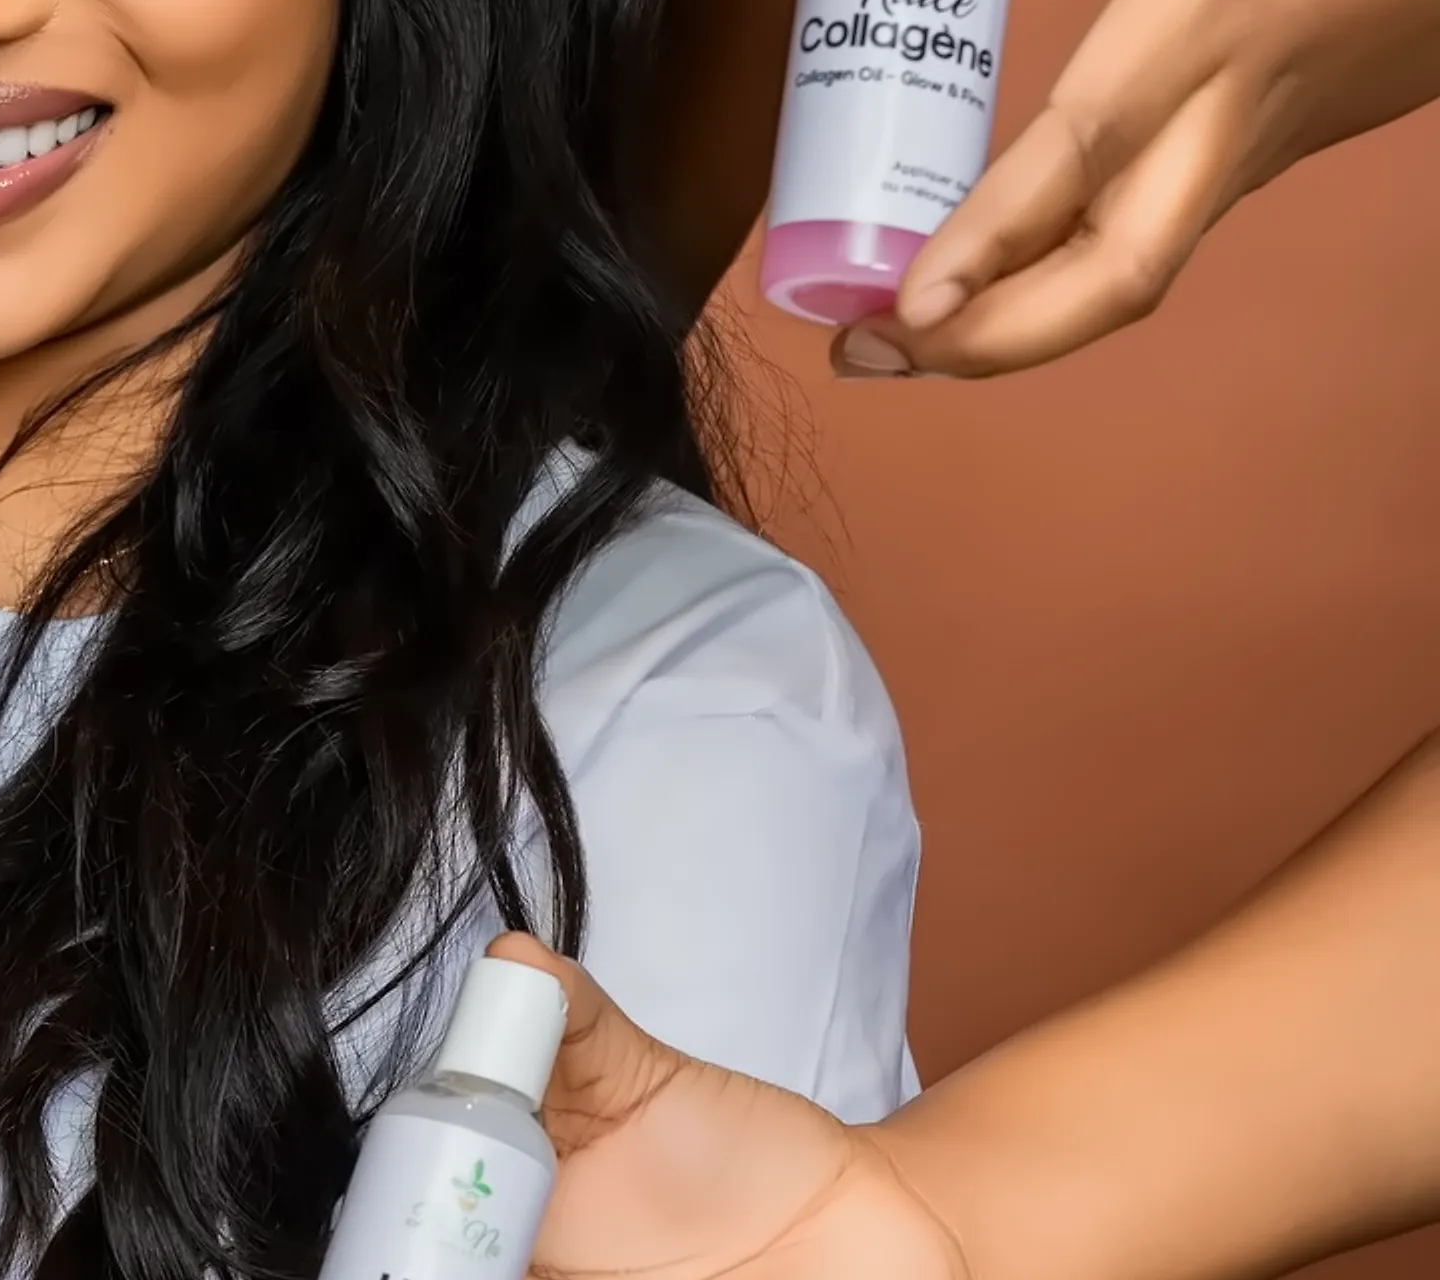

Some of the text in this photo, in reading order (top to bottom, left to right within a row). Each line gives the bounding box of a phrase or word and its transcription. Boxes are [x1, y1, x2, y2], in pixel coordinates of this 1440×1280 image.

[800, 13, 993, 78] Collagène
[795, 68, 855, 88] Collagen
[858, 66, 884, 82] Oil
[901, 71, 943, 93] Glow
